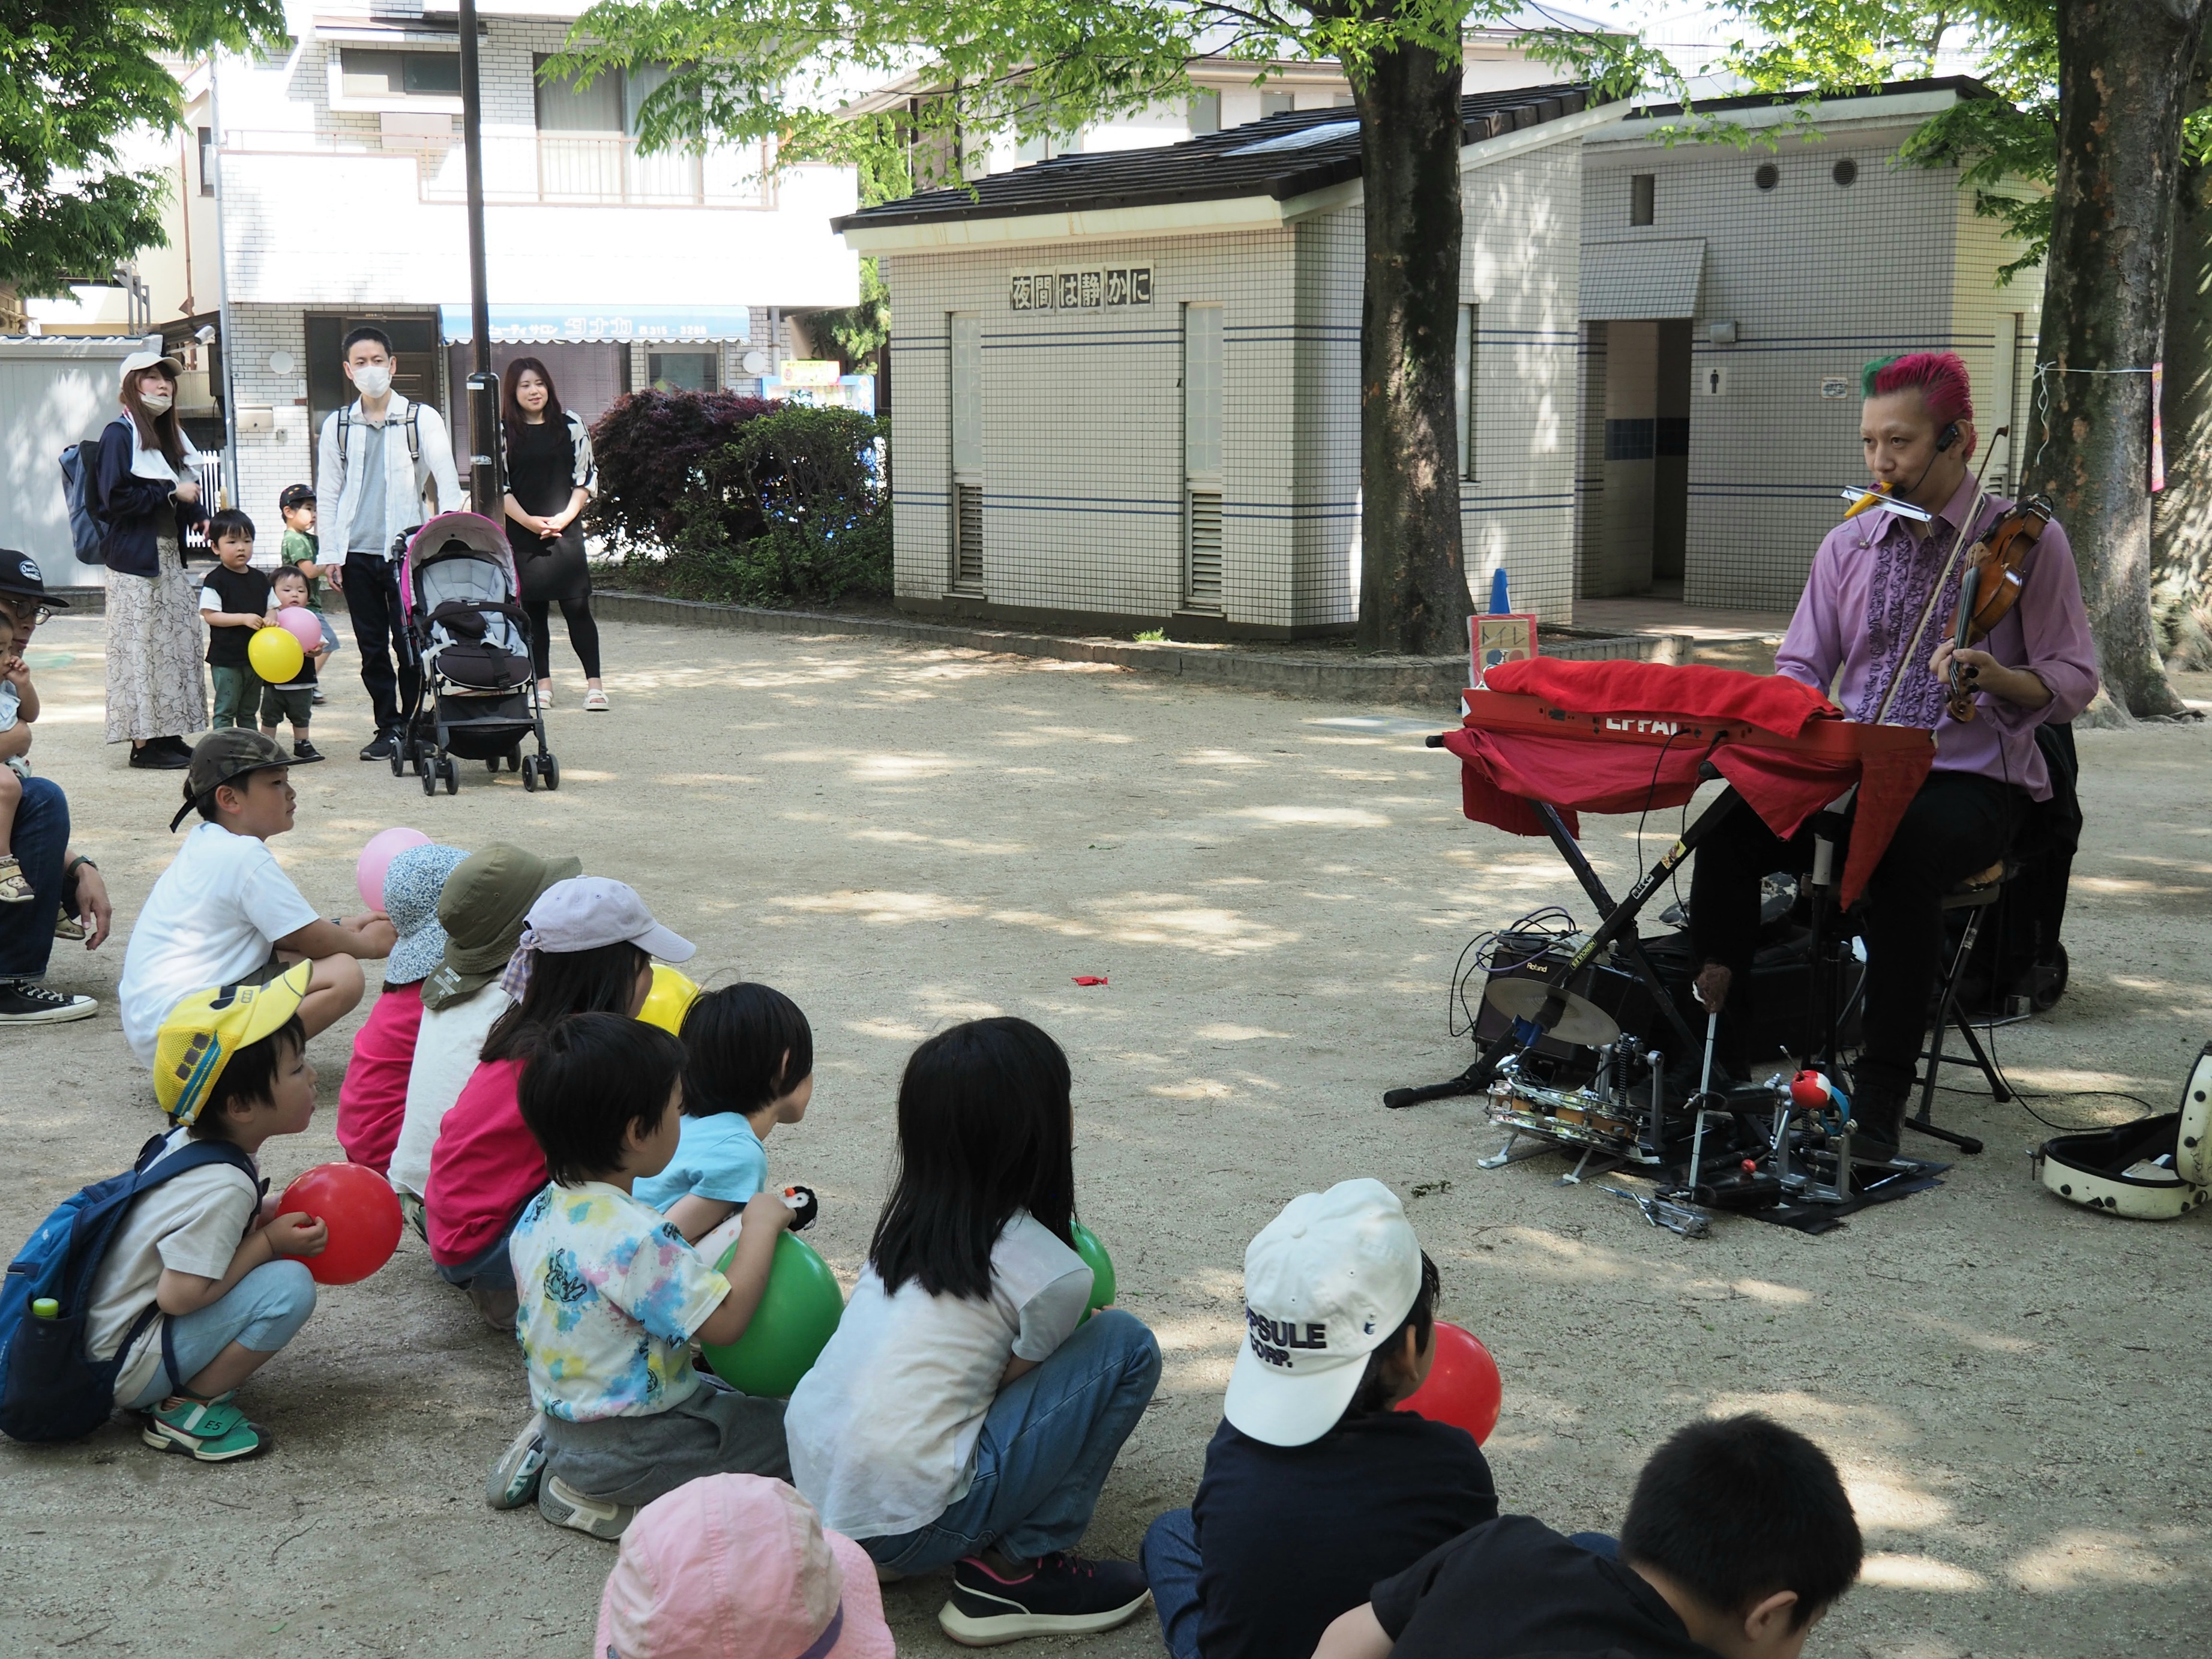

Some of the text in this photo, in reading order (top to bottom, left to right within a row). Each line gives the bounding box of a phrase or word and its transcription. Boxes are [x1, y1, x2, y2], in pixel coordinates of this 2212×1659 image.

[1012, 272, 1150, 309] 夜間は静かに
[565, 317, 632, 334] タナカ
[1482, 625, 1525, 646] トイレ
[1571, 940, 1596, 968] HERCULES
[1527, 962, 1548, 972] Roland
[1246, 1305, 1327, 1349] PSULE
[204, 1420, 223, 1431] E5
